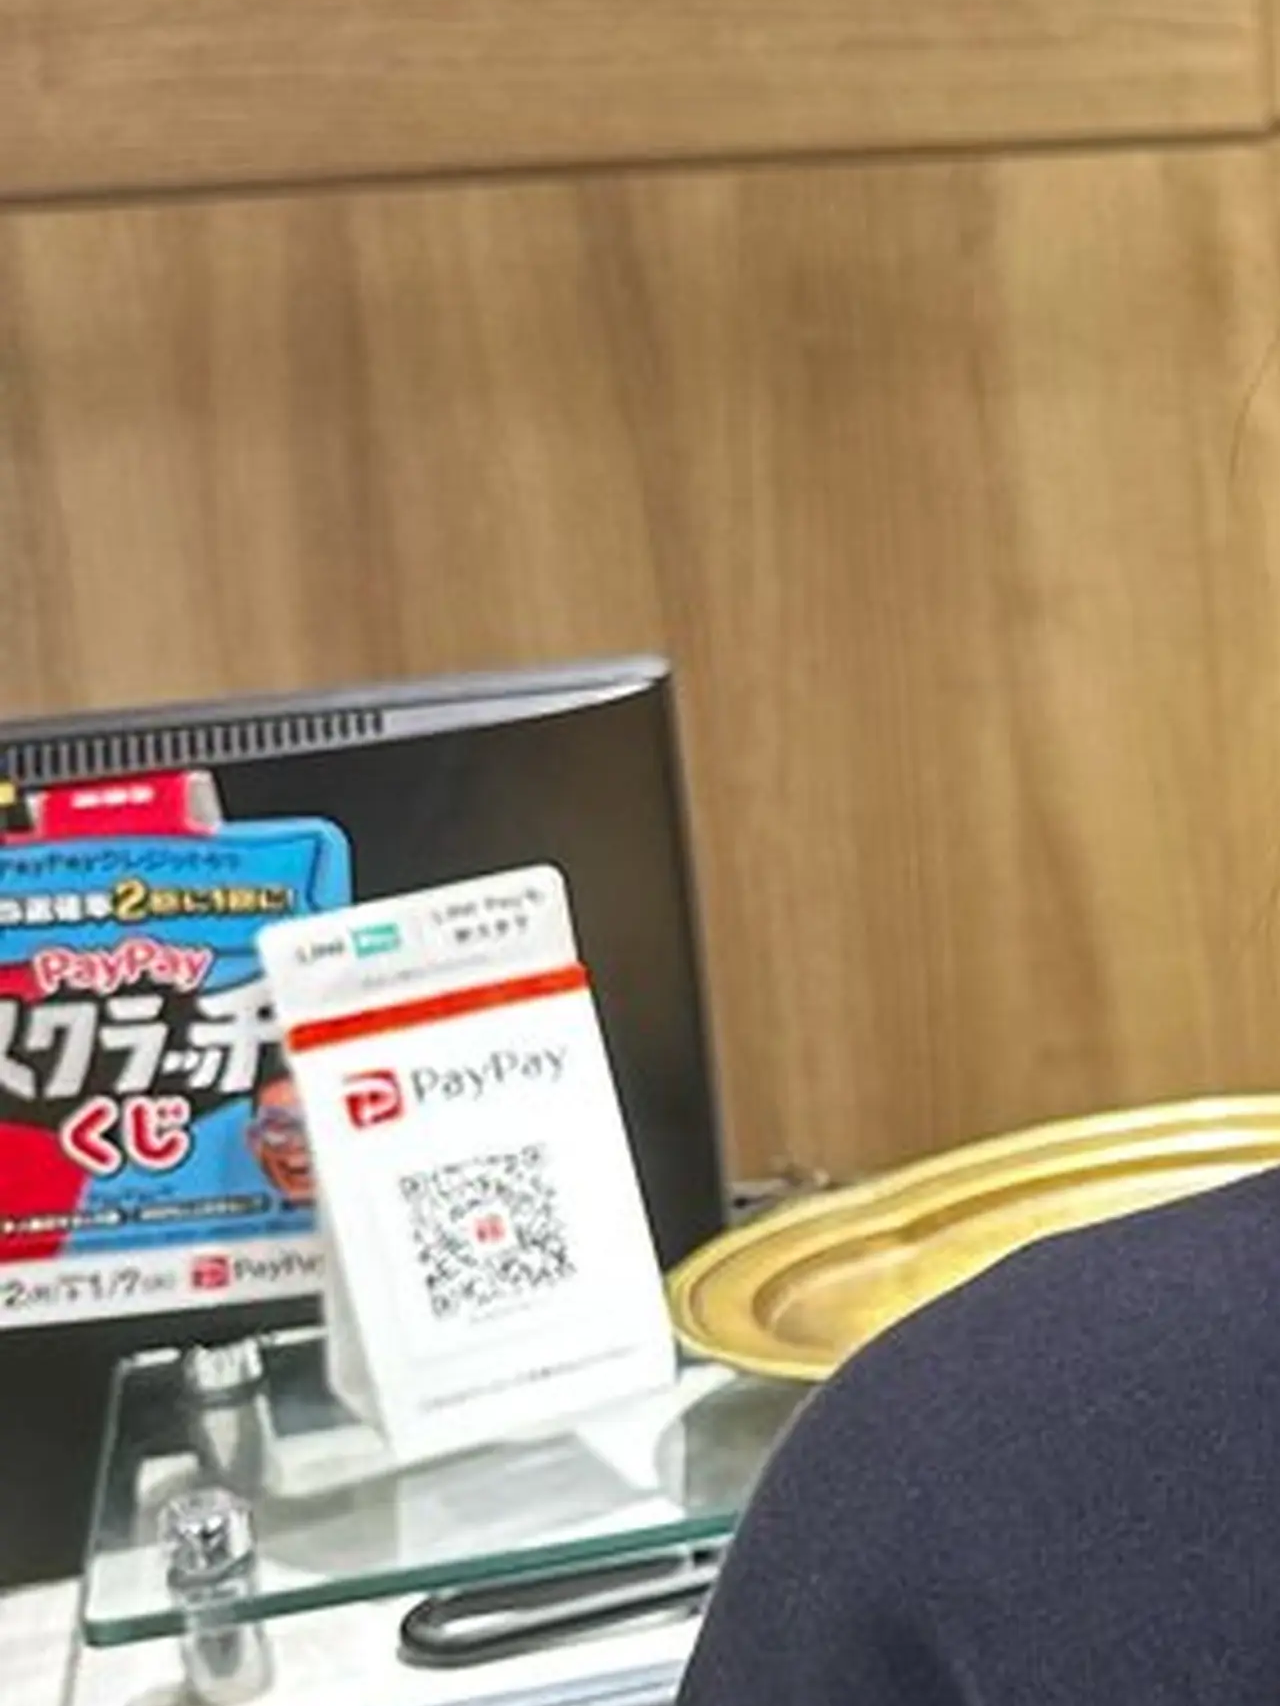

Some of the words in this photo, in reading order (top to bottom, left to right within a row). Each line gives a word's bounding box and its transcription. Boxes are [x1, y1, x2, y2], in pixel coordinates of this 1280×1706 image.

[33, 936, 213, 994] PayPay
[410, 1042, 567, 1104] PayPay
[60, 1095, 191, 1175] くじ
